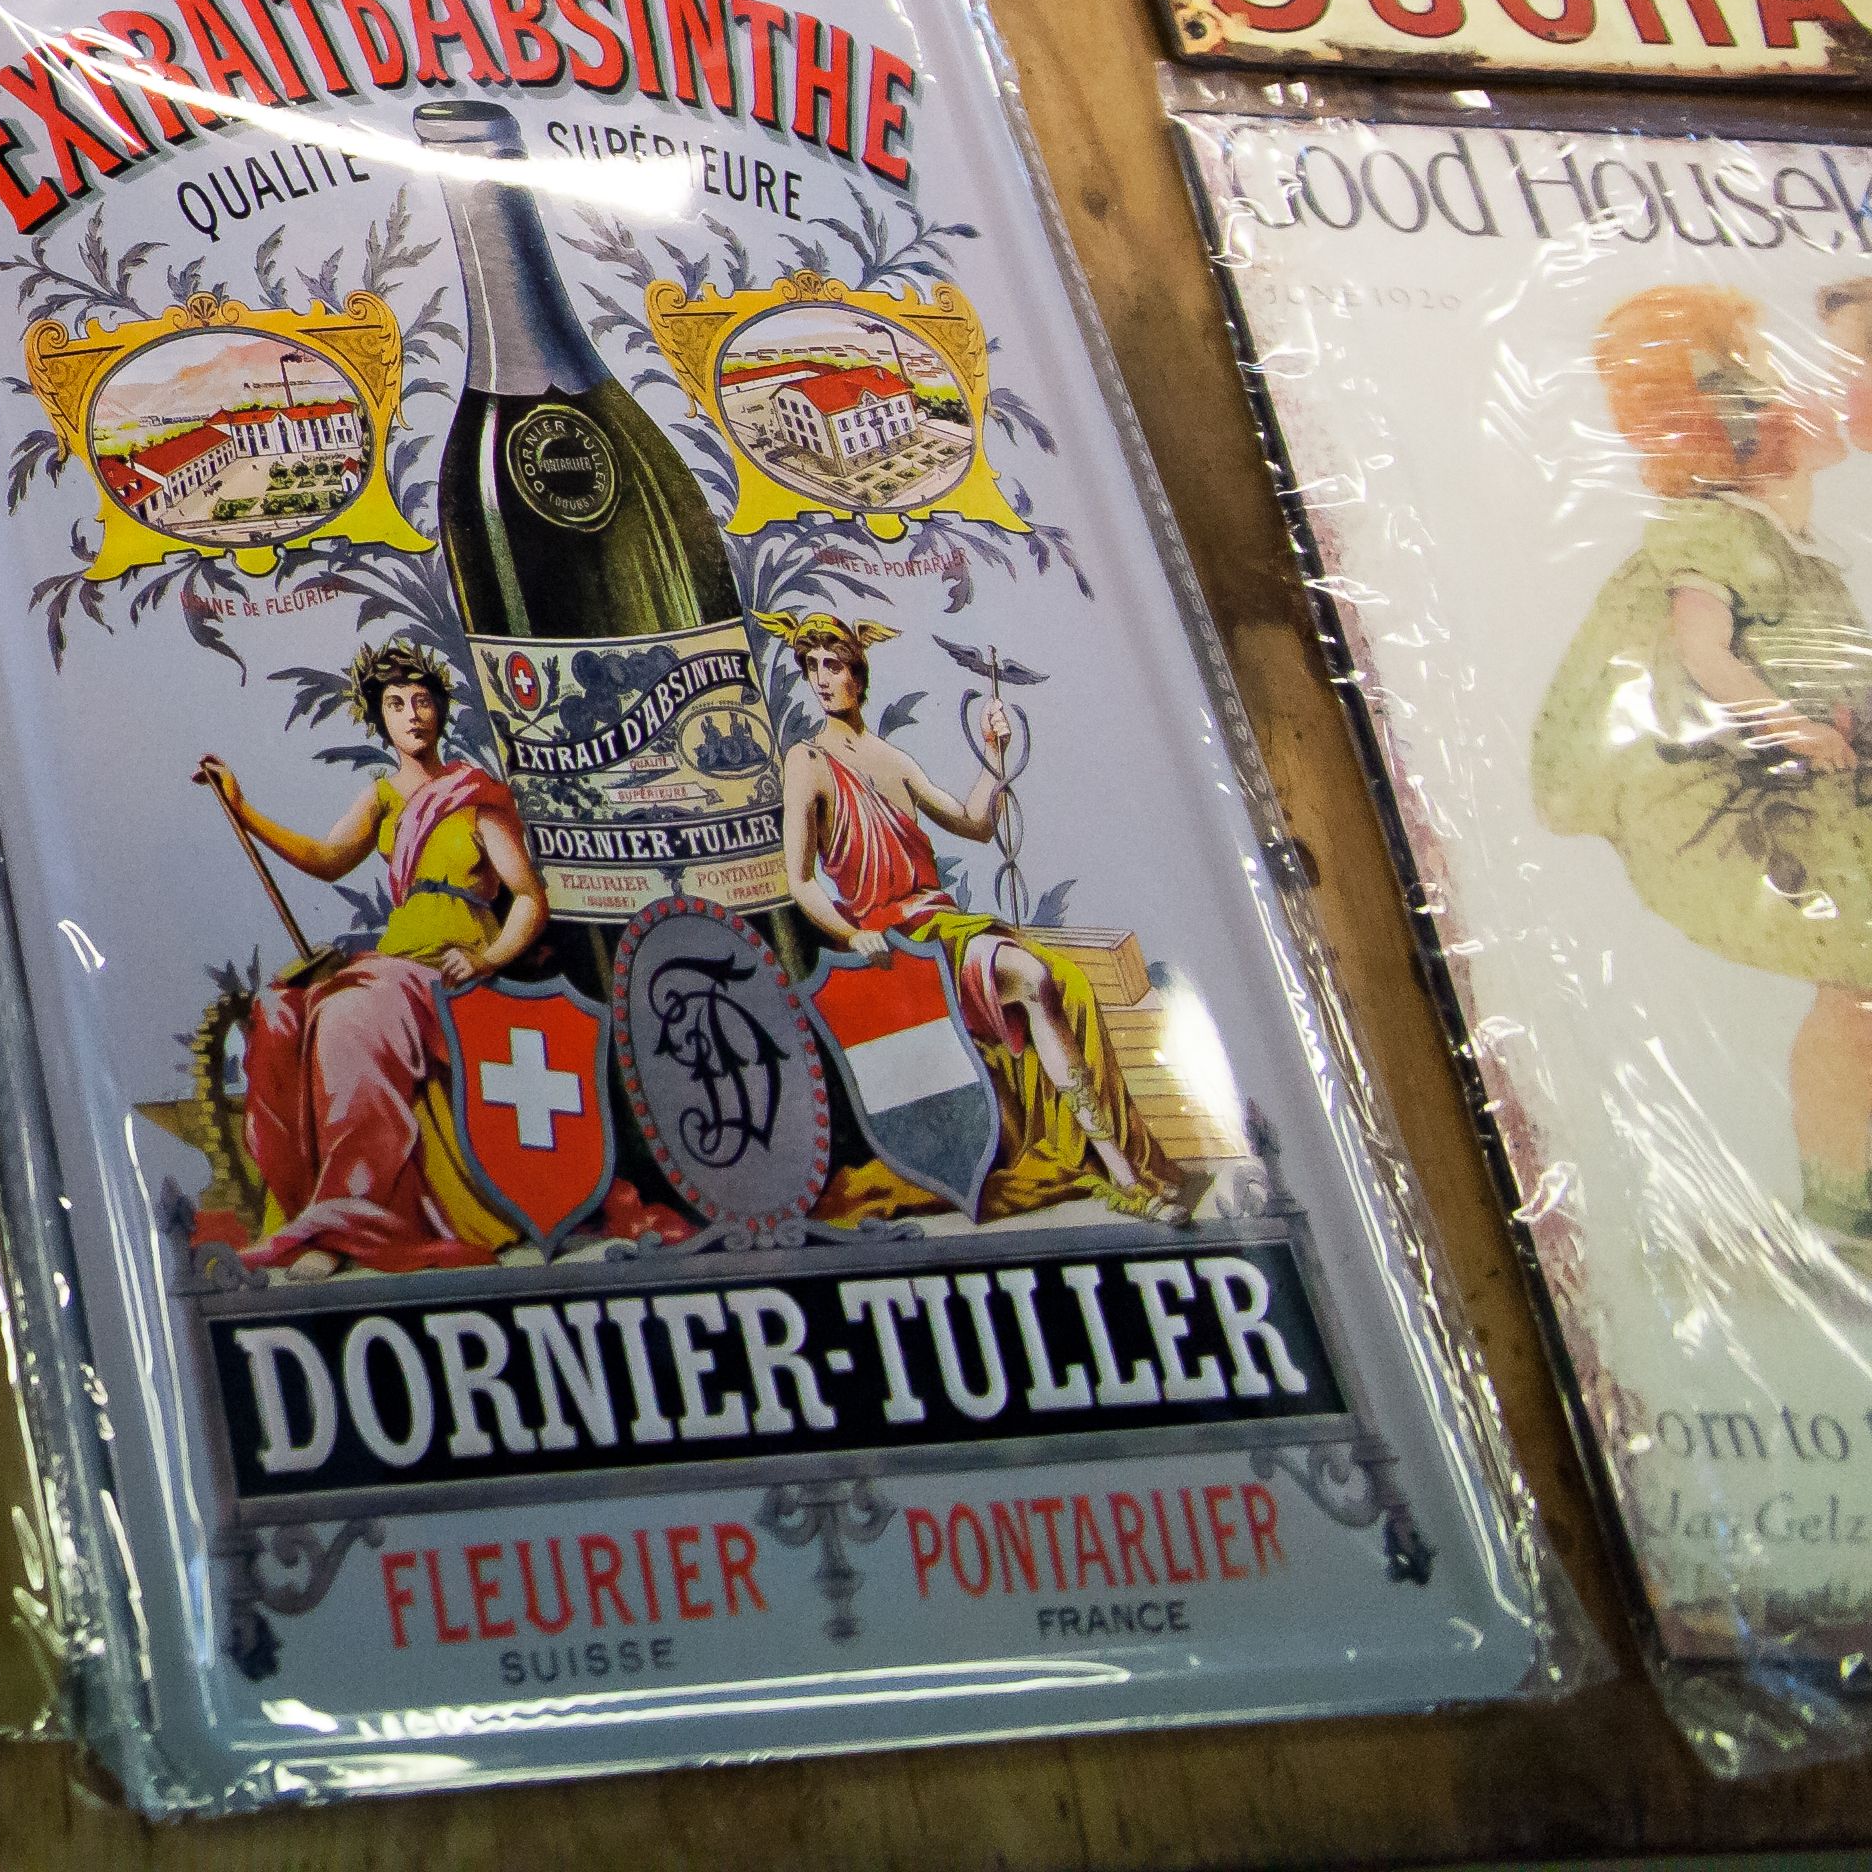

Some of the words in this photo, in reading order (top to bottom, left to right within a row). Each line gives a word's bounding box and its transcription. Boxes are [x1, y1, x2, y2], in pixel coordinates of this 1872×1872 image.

[513, 729, 620, 771] EXTRAIT
[379, 1519, 771, 1650] FLEURIER
[902, 1482, 1289, 1601] PONTARLIER
[498, 1636, 678, 1688] SUISSE
[1036, 1598, 1193, 1640] FRANCE
